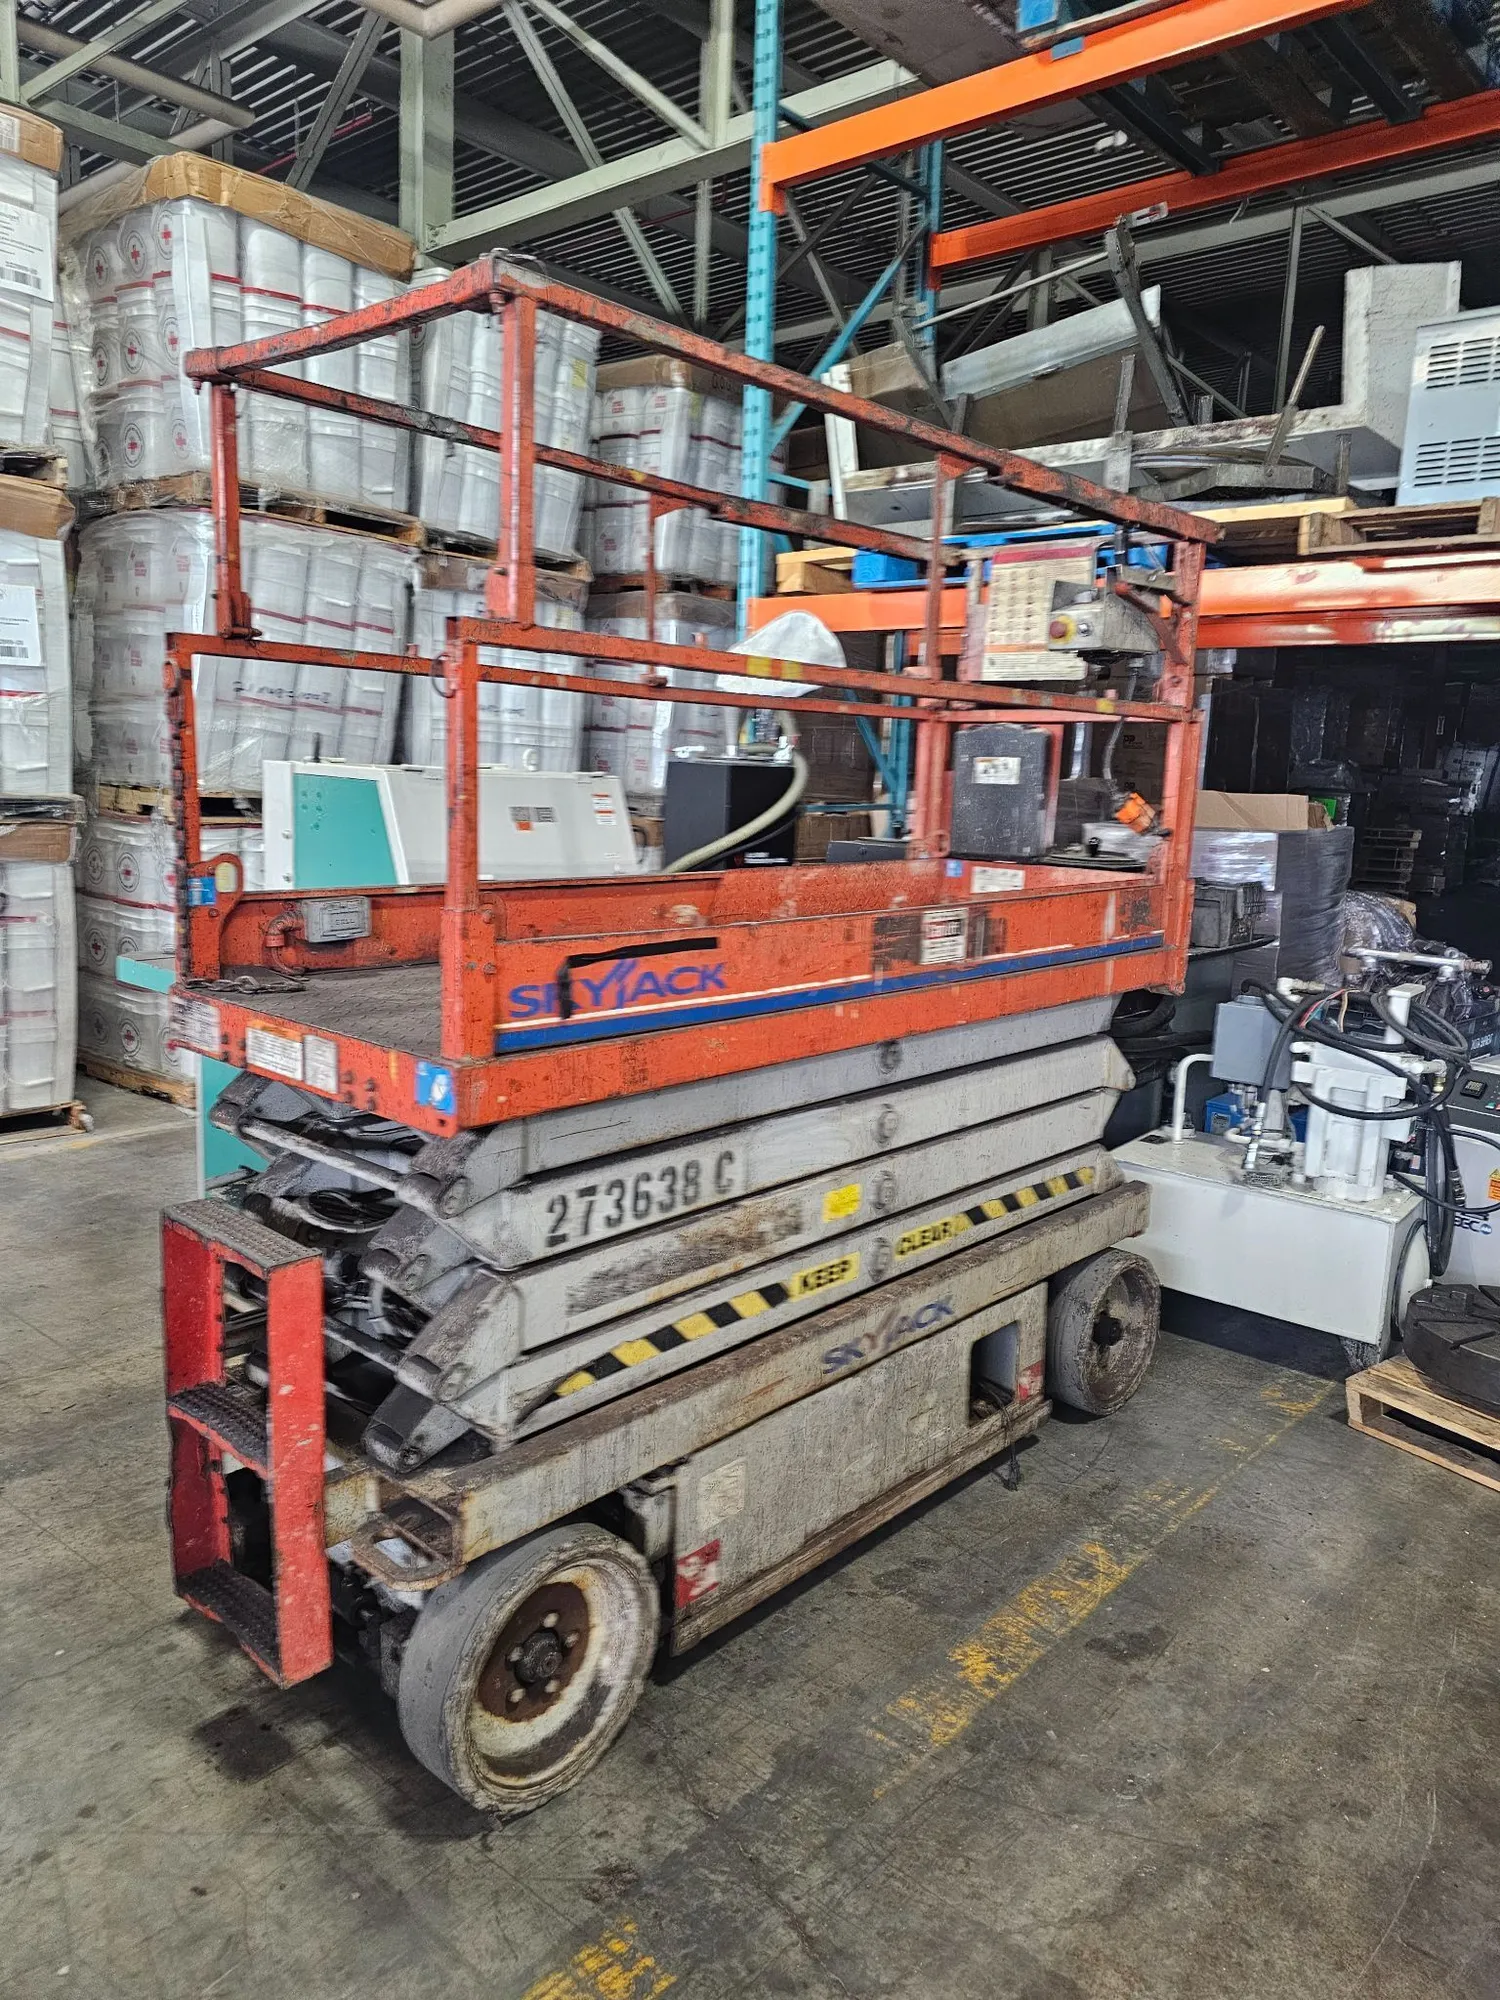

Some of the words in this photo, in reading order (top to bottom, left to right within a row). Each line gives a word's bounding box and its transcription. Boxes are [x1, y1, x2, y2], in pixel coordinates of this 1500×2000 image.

[509, 958, 728, 1018] SKYJACK
[546, 1159, 701, 1248] 273638
[714, 1150, 735, 1194] C
[802, 1259, 850, 1294] KEEP
